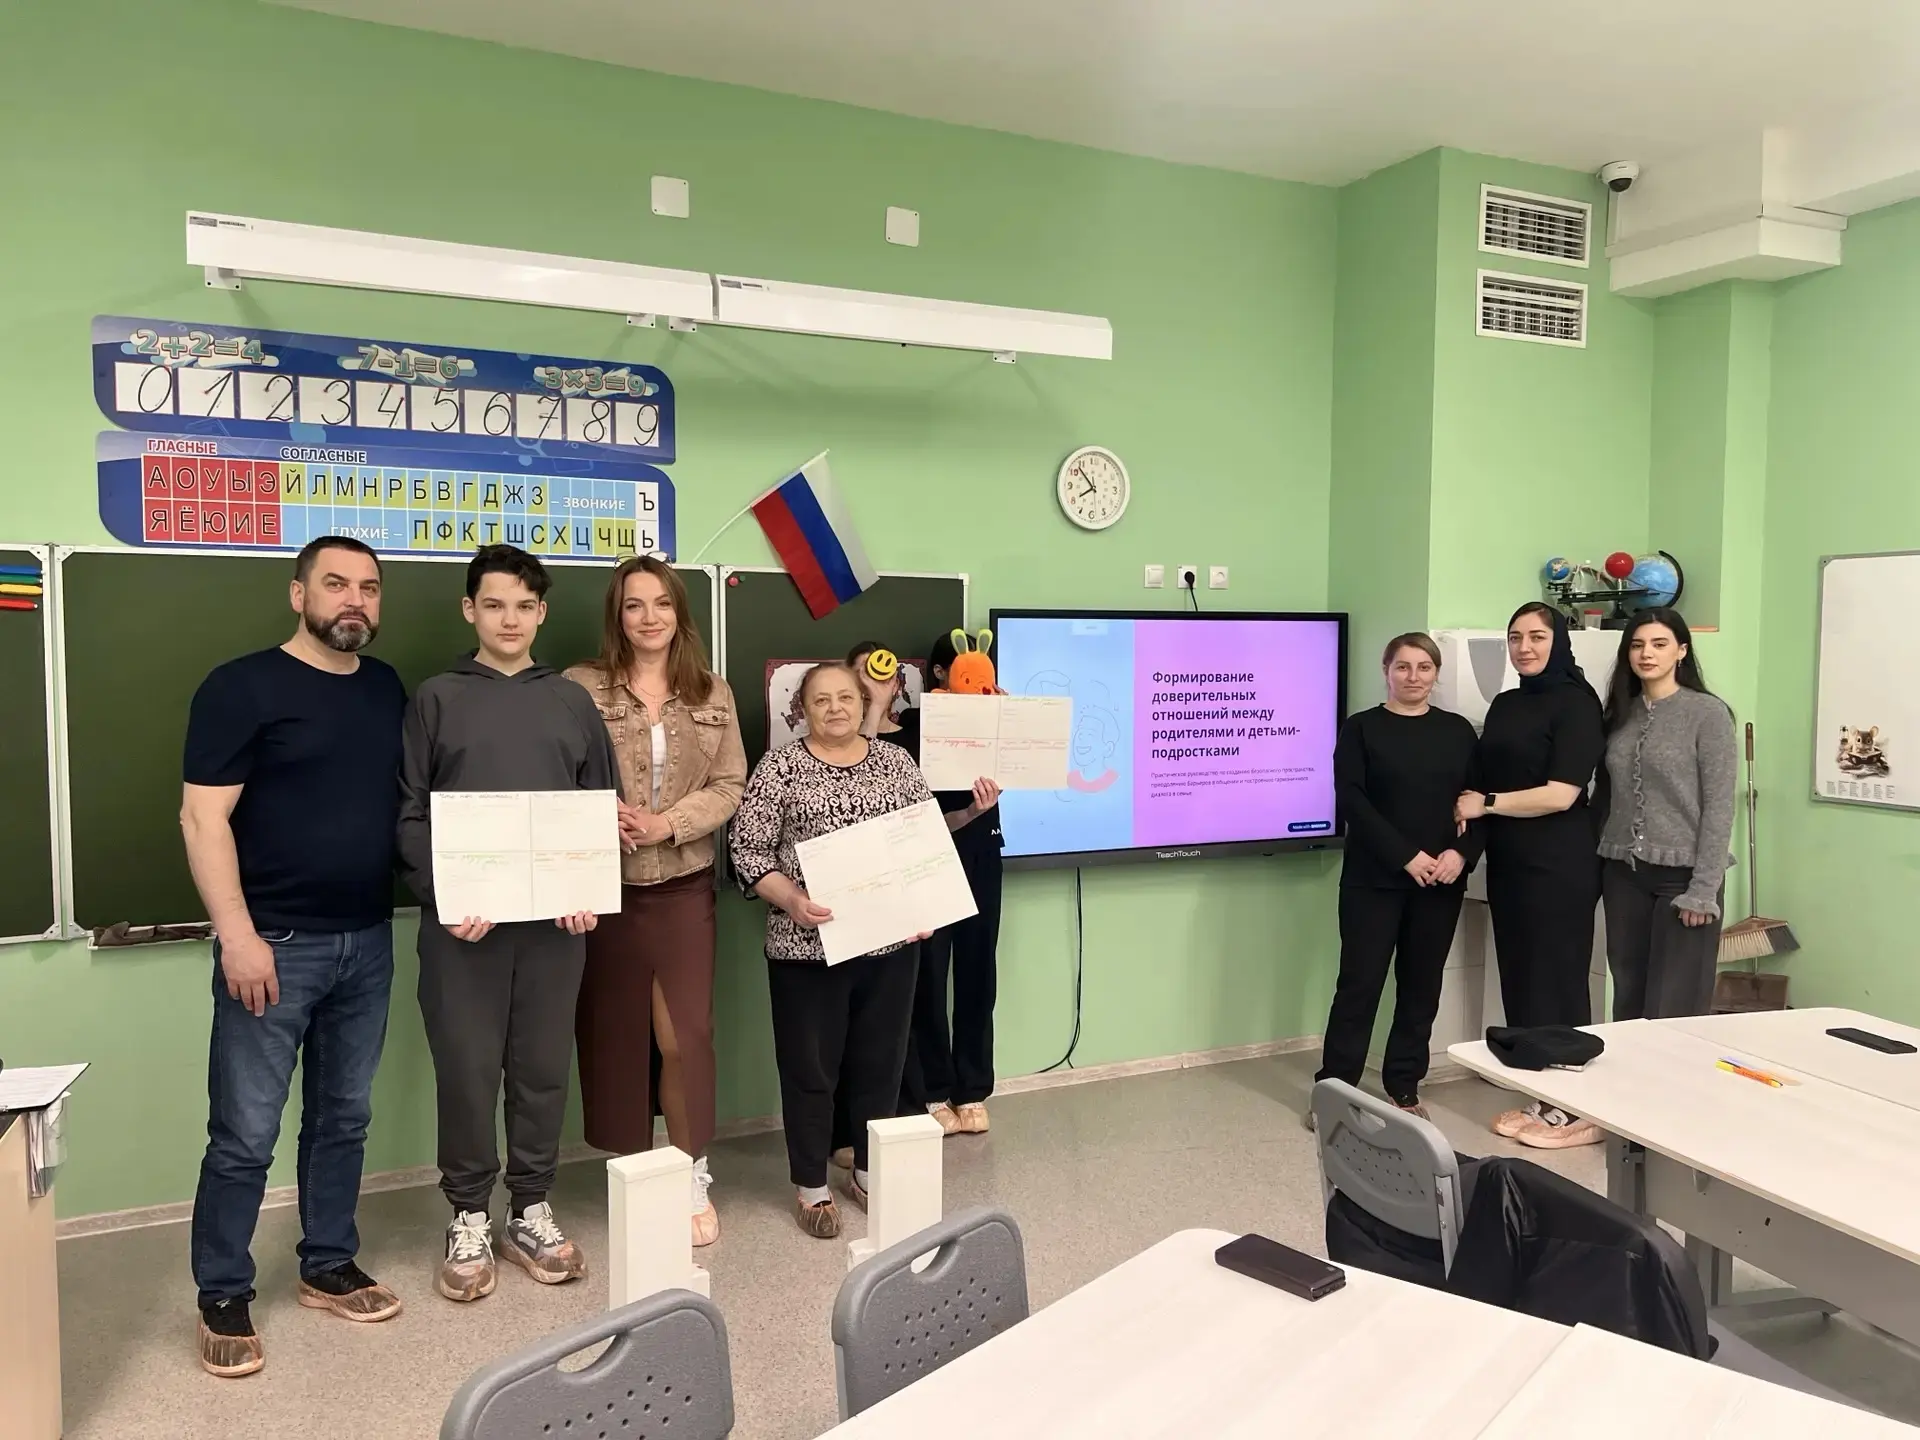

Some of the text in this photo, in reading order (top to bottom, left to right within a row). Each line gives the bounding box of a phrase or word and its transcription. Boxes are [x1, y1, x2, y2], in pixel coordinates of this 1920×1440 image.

[136, 329, 266, 365] 2+2=4
[357, 345, 460, 380] 7-1=6
[138, 365, 659, 446] 0 1 2 3 4 5 6 7 8 9
[147, 439, 217, 455] ГЛАСНЫЕ
[281, 447, 366, 463] СОГЛАСНЫЕ
[149, 466, 167, 488] А
[177, 467, 195, 489] О
[204, 468, 220, 490] У
[232, 471, 251, 492] Ы
[259, 472, 276, 493] Э
[286, 469, 301, 494] Й
[312, 475, 326, 495] Л
[336, 476, 354, 497] М
[363, 477, 378, 497] Н
[389, 479, 403, 499] Р
[414, 480, 426, 500] Б
[438, 481, 450, 501] В
[462, 482, 473, 502] Г
[484, 484, 499, 508] Д
[504, 485, 524, 505] Ж
[531, 486, 543, 506] З
[562, 497, 626, 511] ЗВОНКИЕ
[639, 492, 655, 511] Ъ
[1088, 510, 1095, 519] 6
[151, 510, 168, 531] Я
[180, 506, 195, 532] Ё
[203, 512, 226, 533] Ю
[235, 513, 250, 534] И
[263, 514, 277, 535] Е
[331, 526, 389, 540] ГЛУХИЕ
[414, 519, 428, 540] П
[437, 521, 453, 541] Ф
[462, 522, 474, 541] К
[485, 523, 498, 542] Т
[507, 524, 524, 543] Ш
[531, 525, 545, 544] С
[554, 525, 567, 545] Х
[576, 527, 590, 550] Ц
[599, 528, 611, 547] Ч
[618, 528, 635, 552] Щ
[642, 530, 653, 548] Ь
[1152, 671, 1254, 686] Формирование
[1152, 691, 1256, 705] доверительных
[1152, 707, 1274, 721] отношений между
[1152, 726, 1300, 742] родителями и детьми-
[1152, 746, 1240, 761] подростками
[1156, 850, 1201, 859] TeachTouch
